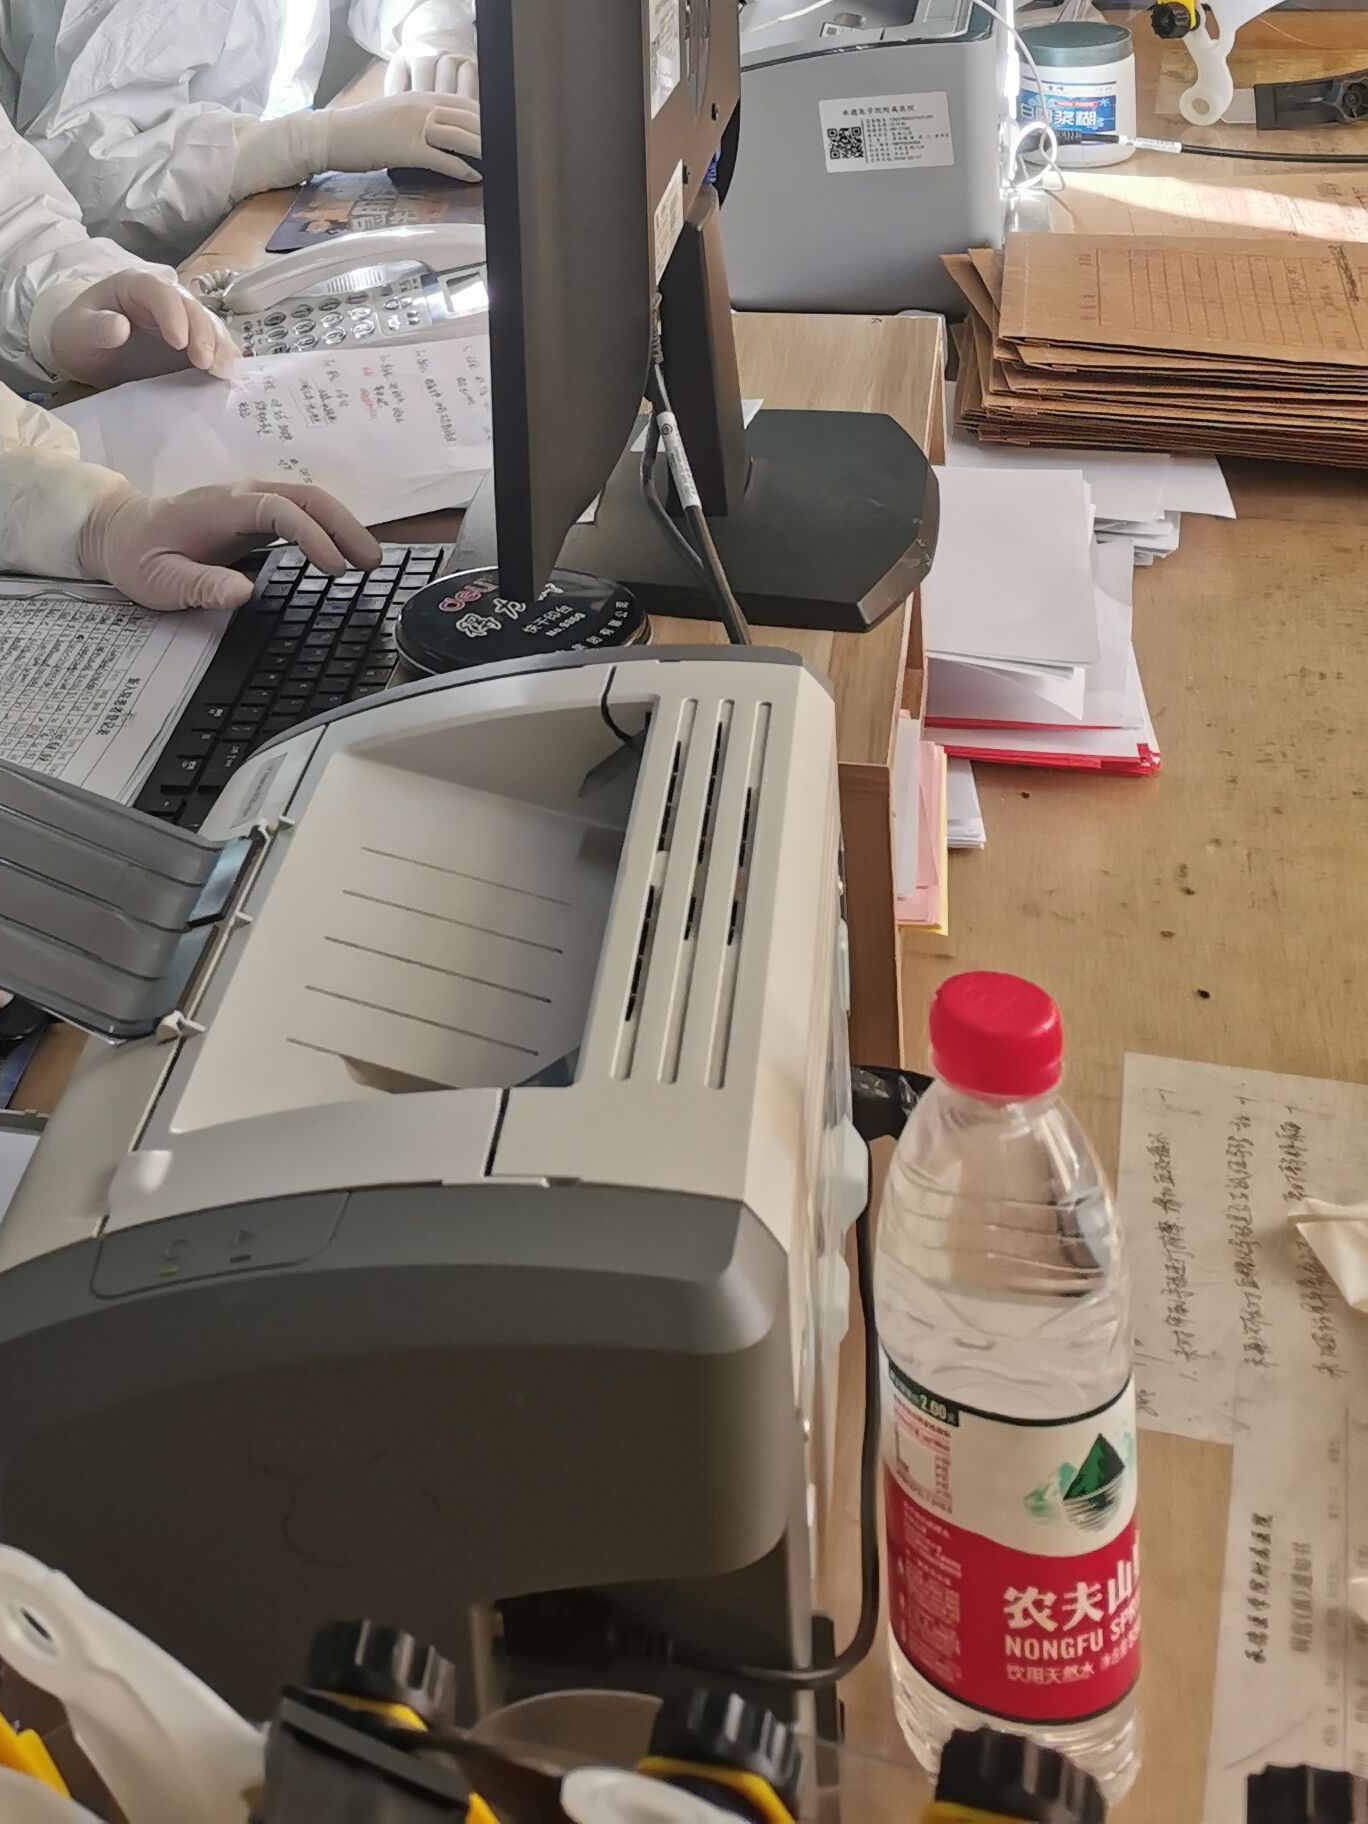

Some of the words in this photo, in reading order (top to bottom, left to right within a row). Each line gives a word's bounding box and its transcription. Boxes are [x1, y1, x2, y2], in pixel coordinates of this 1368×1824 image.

[1003, 1550, 1140, 1632] 农夫山
[1004, 1629, 1105, 1662] NONGFU
